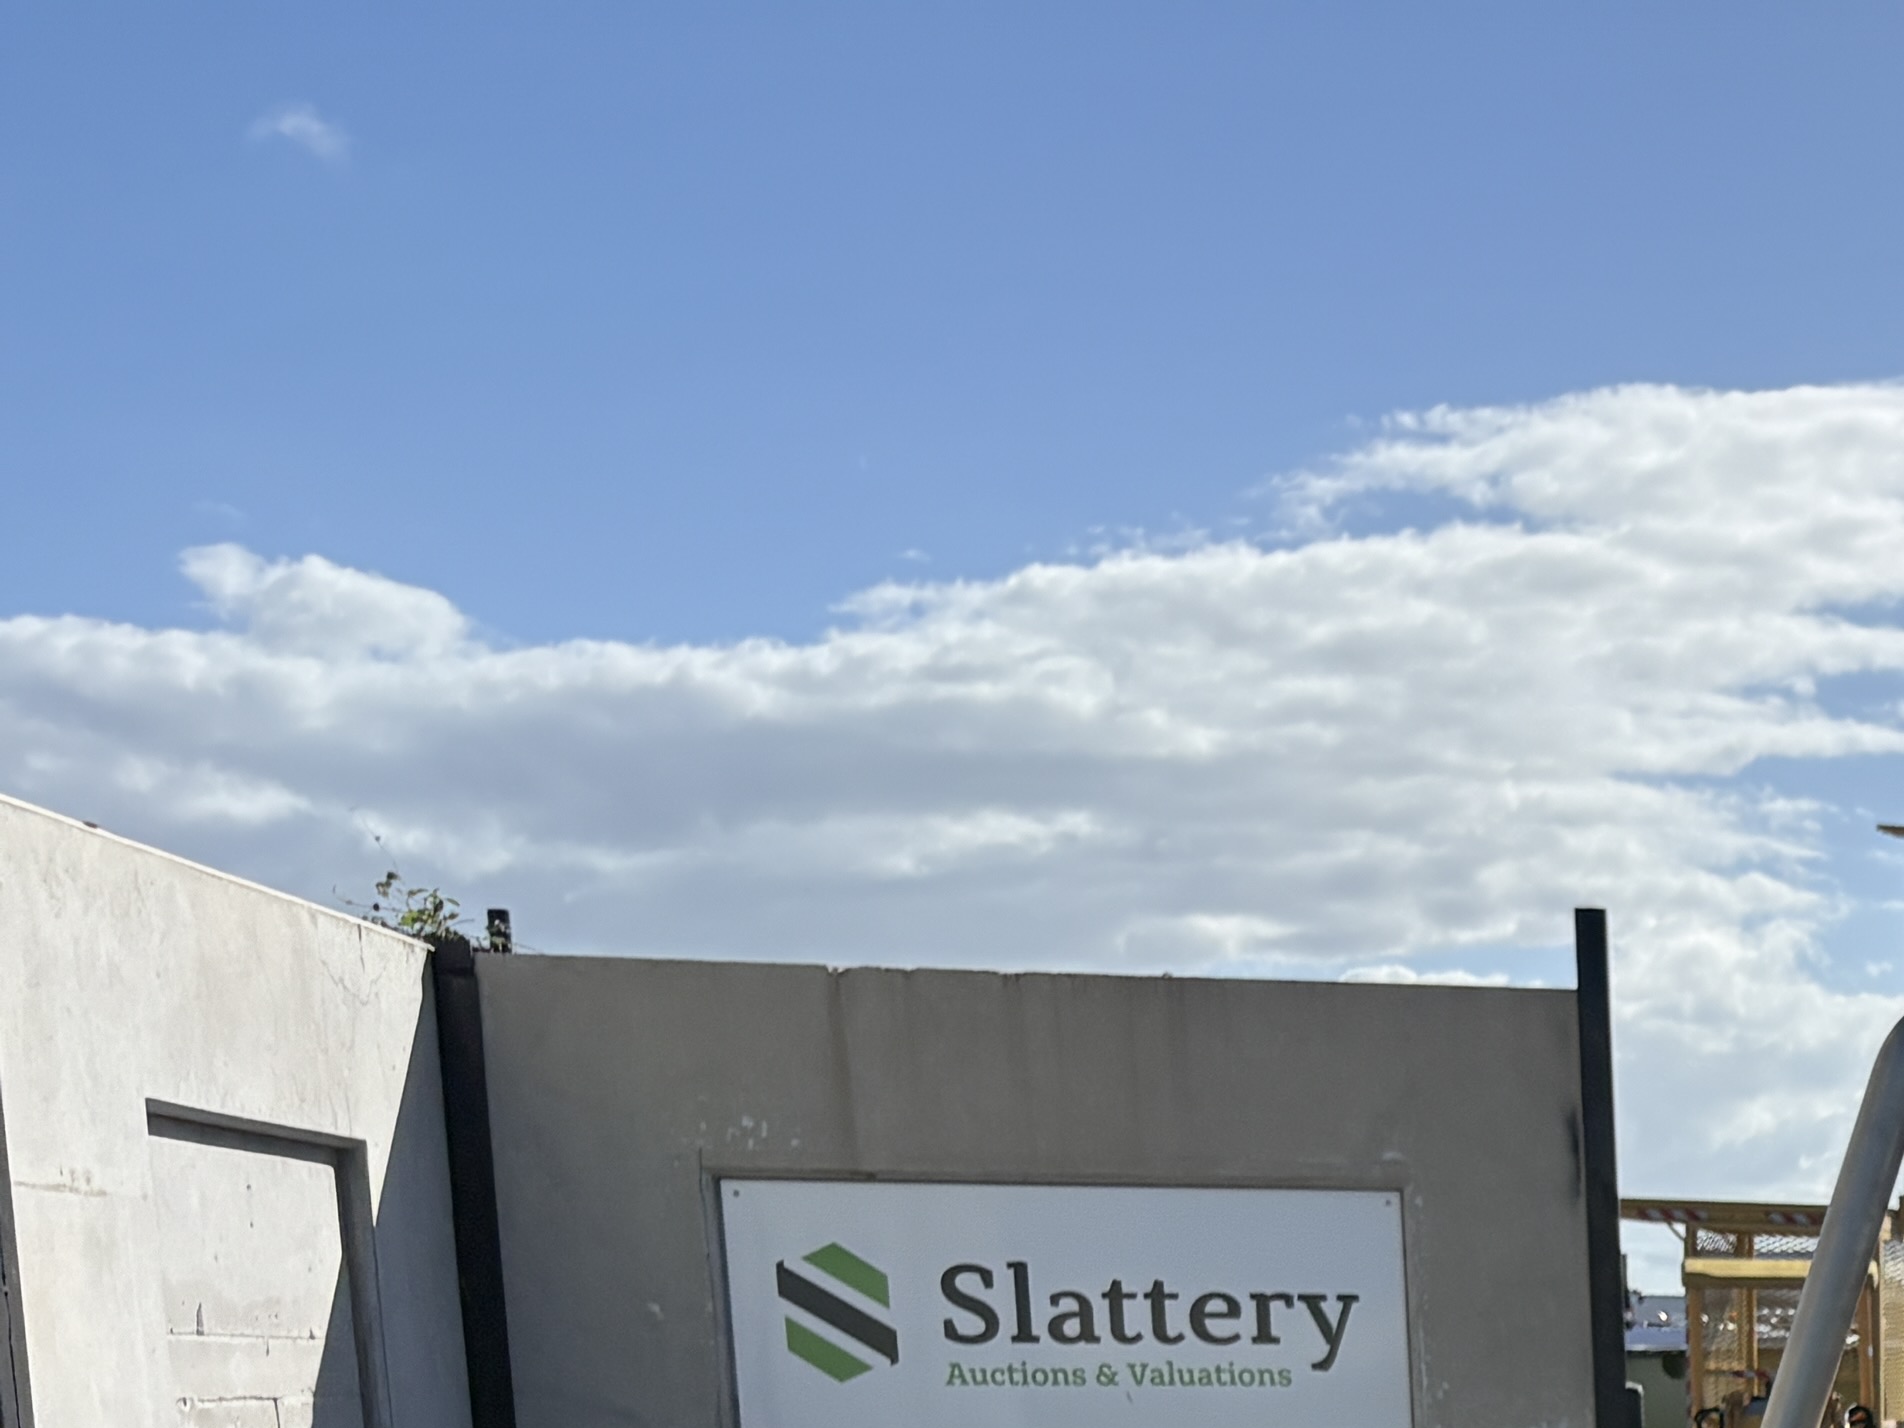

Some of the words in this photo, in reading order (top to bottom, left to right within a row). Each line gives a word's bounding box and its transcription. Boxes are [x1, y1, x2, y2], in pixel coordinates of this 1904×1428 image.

[940, 1261, 1360, 1373] Slattery
[945, 1361, 1087, 1387] Auctions
[1094, 1362, 1119, 1387] &
[1126, 1360, 1292, 1388] Valuations
